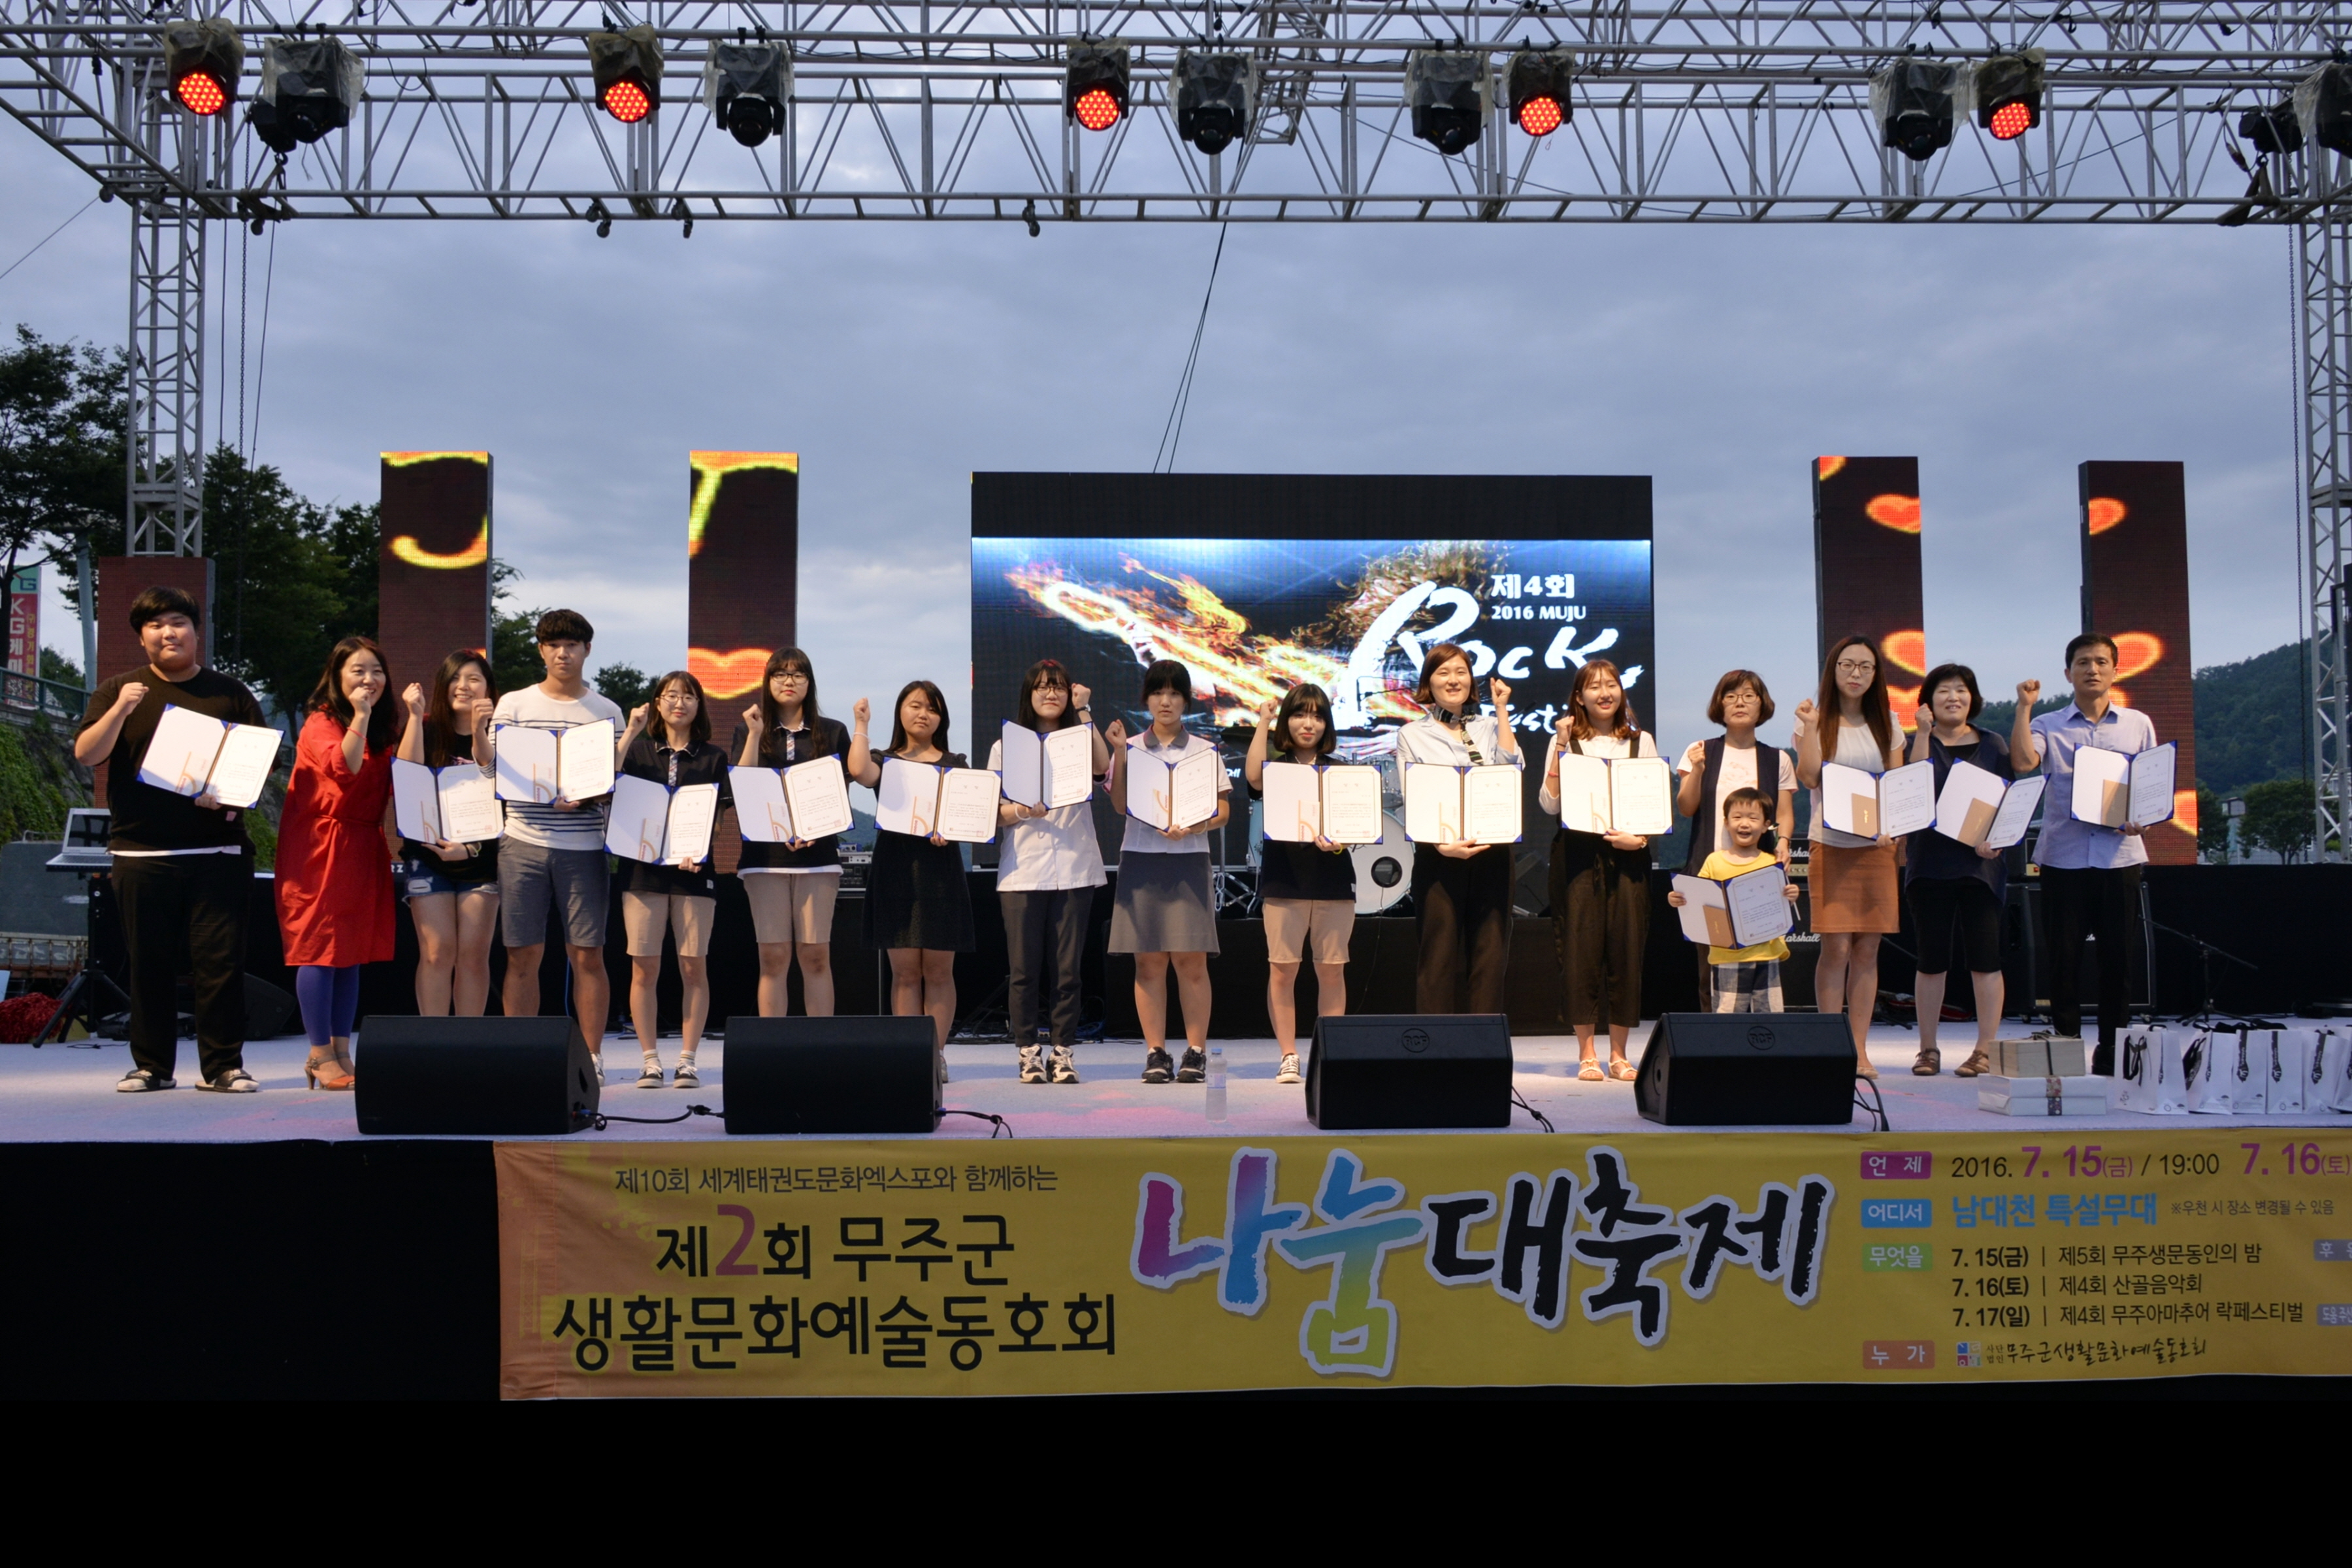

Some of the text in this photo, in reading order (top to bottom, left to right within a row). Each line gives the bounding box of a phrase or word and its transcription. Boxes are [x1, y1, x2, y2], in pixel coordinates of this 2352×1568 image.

[1491, 574, 1575, 599] 제4회
[1491, 606, 1586, 621] 2016 MUJU
[1785, 932, 1821, 942] arshall
[1403, 1036, 1429, 1047] RCF
[1749, 1034, 1775, 1045] RCF
[1952, 1156, 2012, 1177] 2016.
[2159, 1152, 2219, 1175] 19:00
[615, 1165, 1058, 1194] 제10회 세계태권도문화엑스포와 함께하는
[1868, 1204, 1922, 1222] 어디서
[1953, 1192, 2157, 1228] 남대천 특설무대
[2212, 1200, 2223, 1216] 시
[2227, 1200, 2252, 1216] 장소
[2255, 1200, 2291, 1216] 변경될
[2295, 1201, 2308, 1215] 수
[2310, 1200, 2335, 1215] 있음
[657, 1204, 1015, 1285] 제2회 무주군
[2059, 1245, 2106, 1266] 제5회
[2112, 1243, 2237, 1266] 무주생문동인의
[2244, 1243, 2262, 1264] 밤
[1869, 1245, 1923, 1268] 무엇을
[2059, 1275, 2107, 1296] 제4회
[2113, 1273, 2202, 1296] 산골음악회
[2060, 1305, 2106, 1326] 제4회
[2111, 1301, 2210, 1326] 무주아마추어
[2216, 1301, 2304, 1322] 락페스티벌
[553, 1292, 1115, 1371] 생활문화예술동호회
[1986, 1345, 2004, 1354] 사단
[1986, 1354, 2004, 1364] 법인
[2006, 1337, 2207, 1366] 무주군생활문화예술동호회
